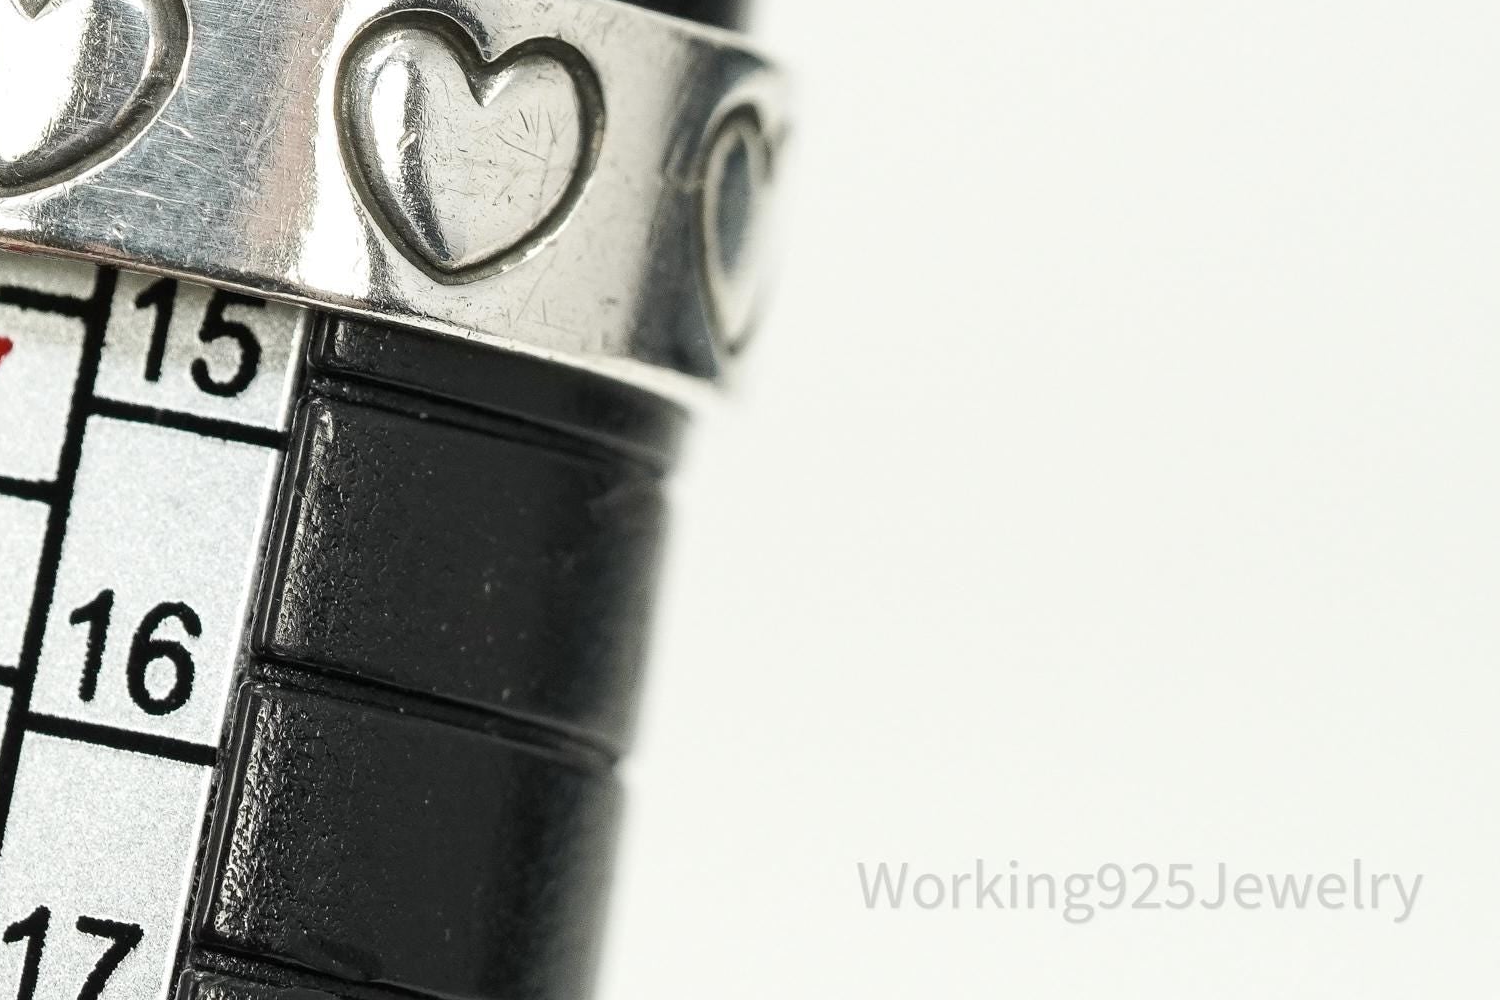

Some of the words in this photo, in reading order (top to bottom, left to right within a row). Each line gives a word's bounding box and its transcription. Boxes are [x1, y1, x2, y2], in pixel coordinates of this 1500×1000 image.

[133, 278, 268, 399] 15
[68, 588, 203, 717] 16
[1, 905, 145, 1000] 17
